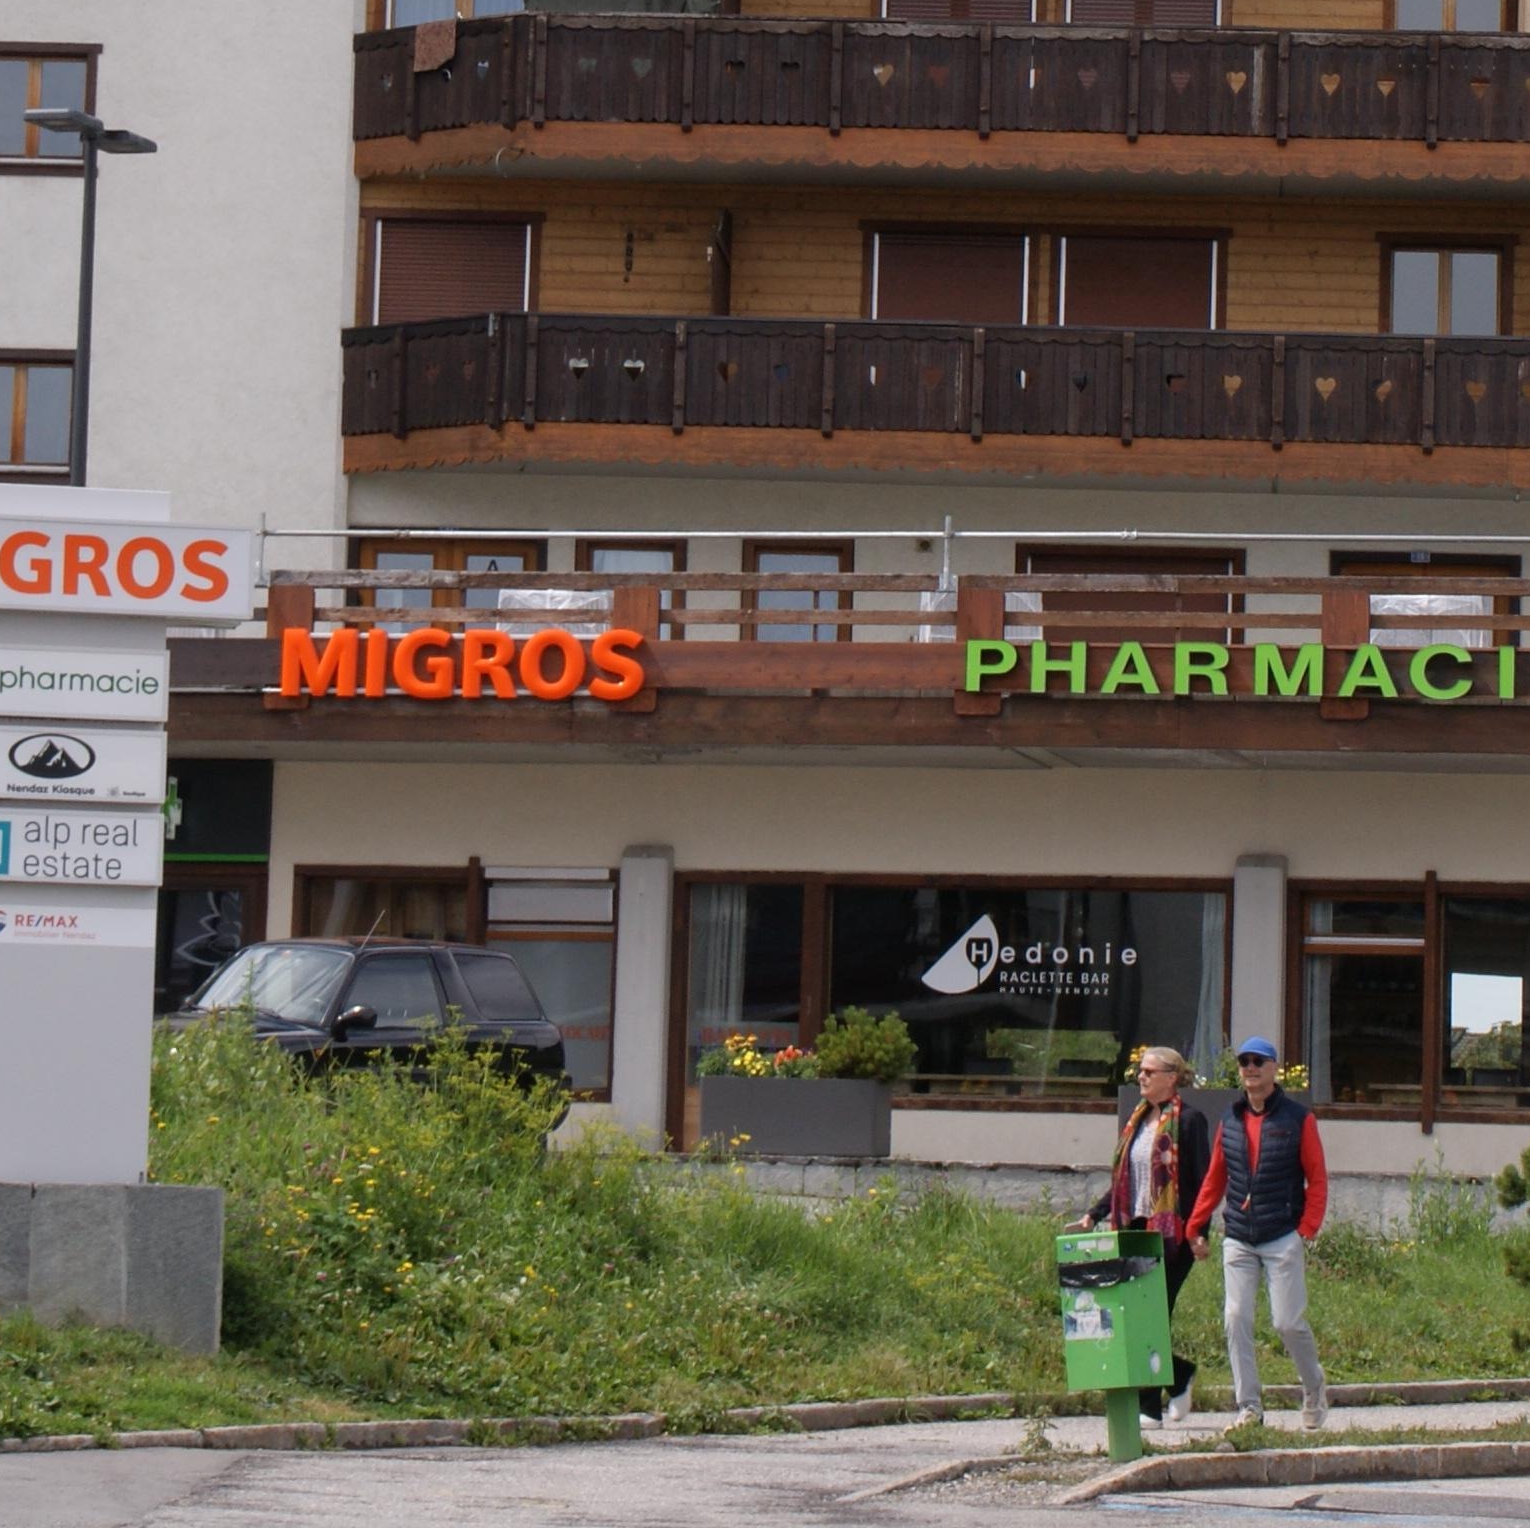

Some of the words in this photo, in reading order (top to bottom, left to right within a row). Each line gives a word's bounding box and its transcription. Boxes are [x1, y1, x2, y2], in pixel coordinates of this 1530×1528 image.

[280, 628, 646, 700] MIGROS
[6, 783, 49, 794] Nendaz
[52, 784, 95, 798] Kiosque
[23, 815, 71, 849] alp
[81, 819, 138, 847] real
[23, 853, 122, 880] estate
[14, 914, 79, 928] RE/MAX
[970, 941, 1138, 966] Hedonie
[999, 971, 1074, 984] RACLETTE
[1081, 972, 1110, 985] BAR
[999, 986, 1110, 996] HAUTE-NENDAZ
